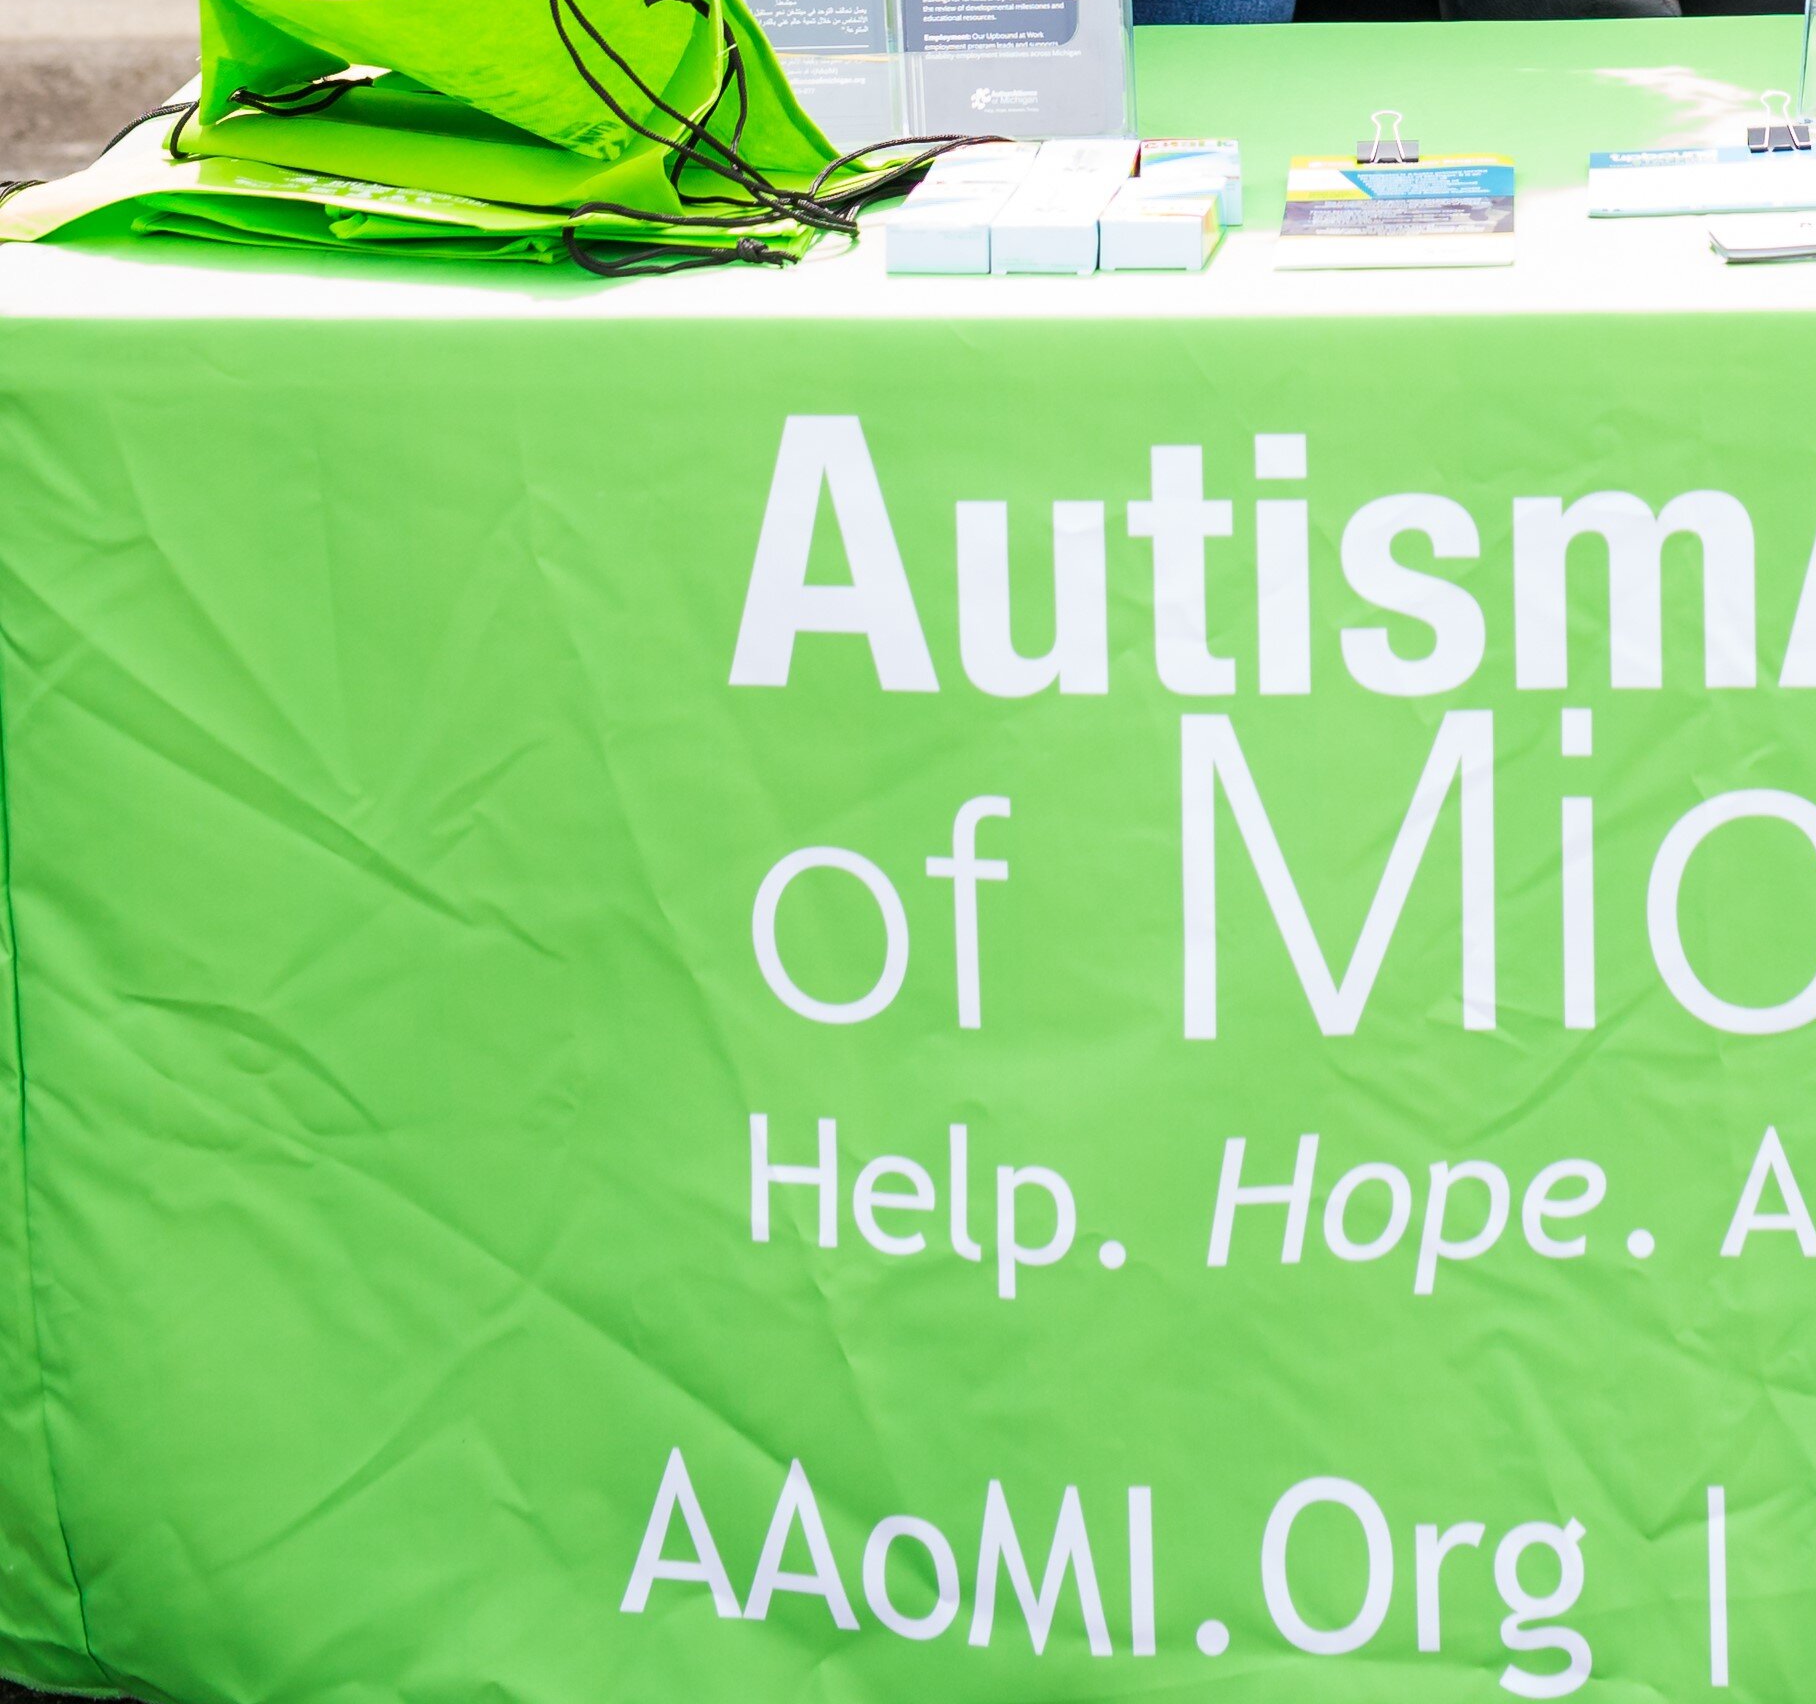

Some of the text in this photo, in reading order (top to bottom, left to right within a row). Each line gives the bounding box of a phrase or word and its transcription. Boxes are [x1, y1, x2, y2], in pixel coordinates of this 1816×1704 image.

[752, 794, 1012, 1028] of
[750, 1114, 1126, 1298] Help.
[1208, 1134, 1654, 1294] Hope.
[620, 1448, 1591, 1698] AAoMI.Org
